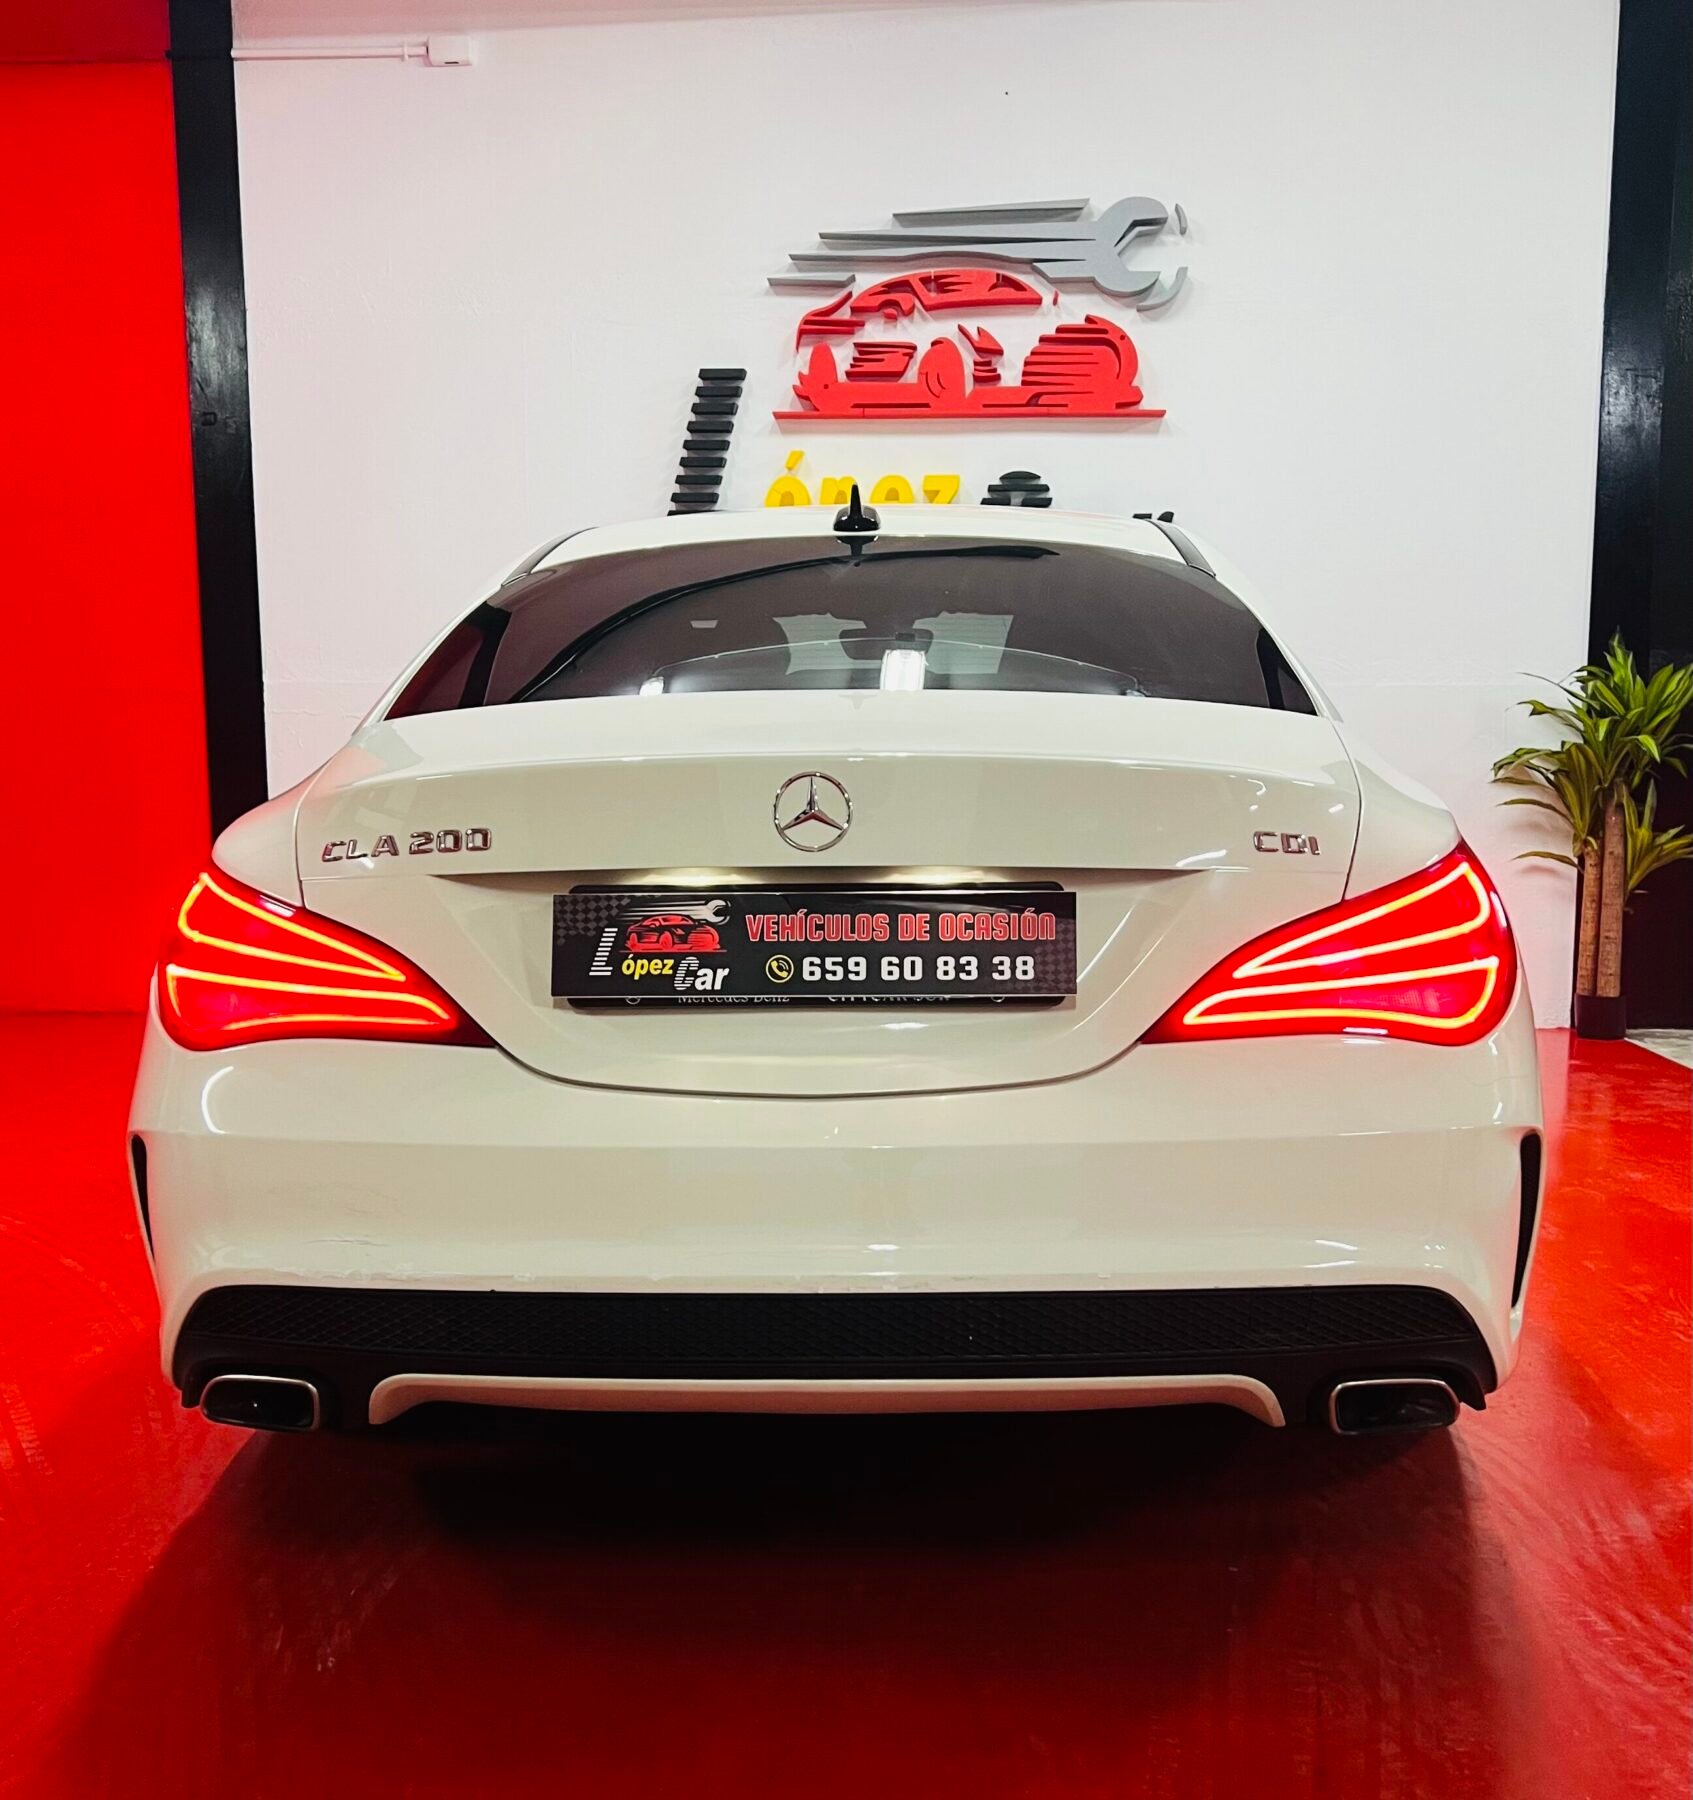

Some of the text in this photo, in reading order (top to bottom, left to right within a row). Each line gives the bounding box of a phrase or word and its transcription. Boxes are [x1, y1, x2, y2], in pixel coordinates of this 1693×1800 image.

[321, 827, 492, 862] CLA 200
[1253, 831, 1321, 855] CDI
[745, 908, 890, 942] VEHÍCULOS
[898, 913, 930, 941] DE
[673, 956, 730, 991] Car
[802, 955, 1035, 981] 659 60 83 38
